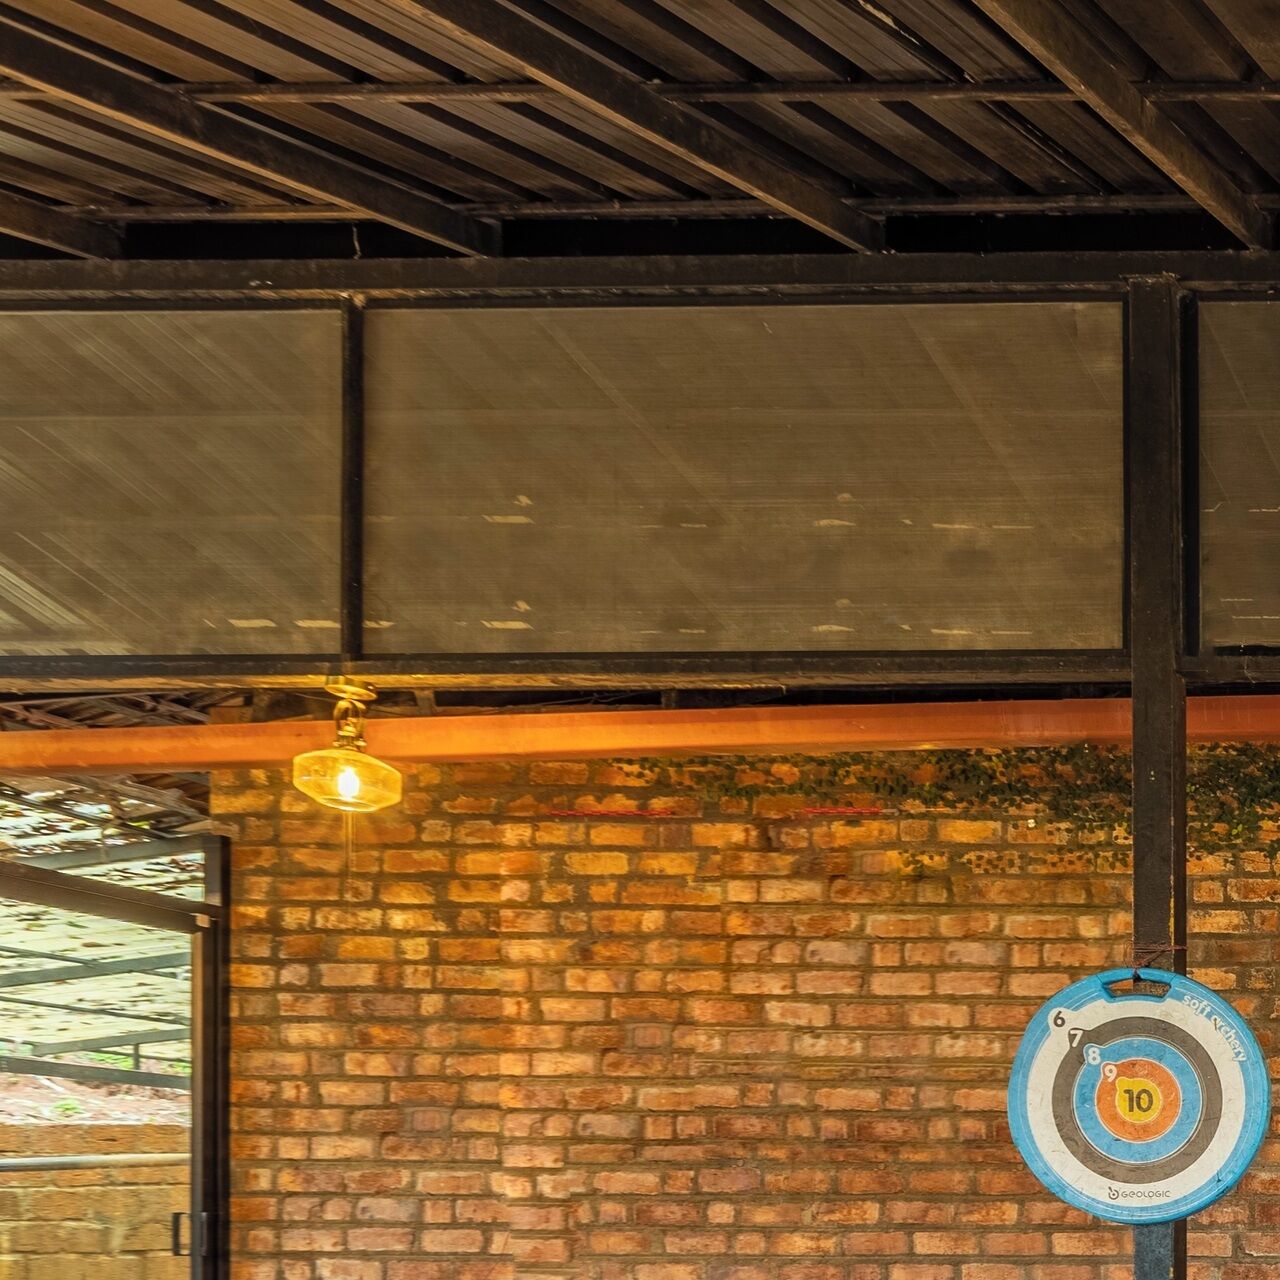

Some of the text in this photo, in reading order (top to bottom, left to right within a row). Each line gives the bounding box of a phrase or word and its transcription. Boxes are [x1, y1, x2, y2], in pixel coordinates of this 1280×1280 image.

[1053, 1011, 1066, 1028] 6
[1182, 994, 1249, 1063] soft archery
[1069, 1029, 1084, 1048] 7
[1086, 1047, 1101, 1066] 8
[1104, 1064, 1118, 1082] 9
[1124, 1088, 1154, 1113] 10
